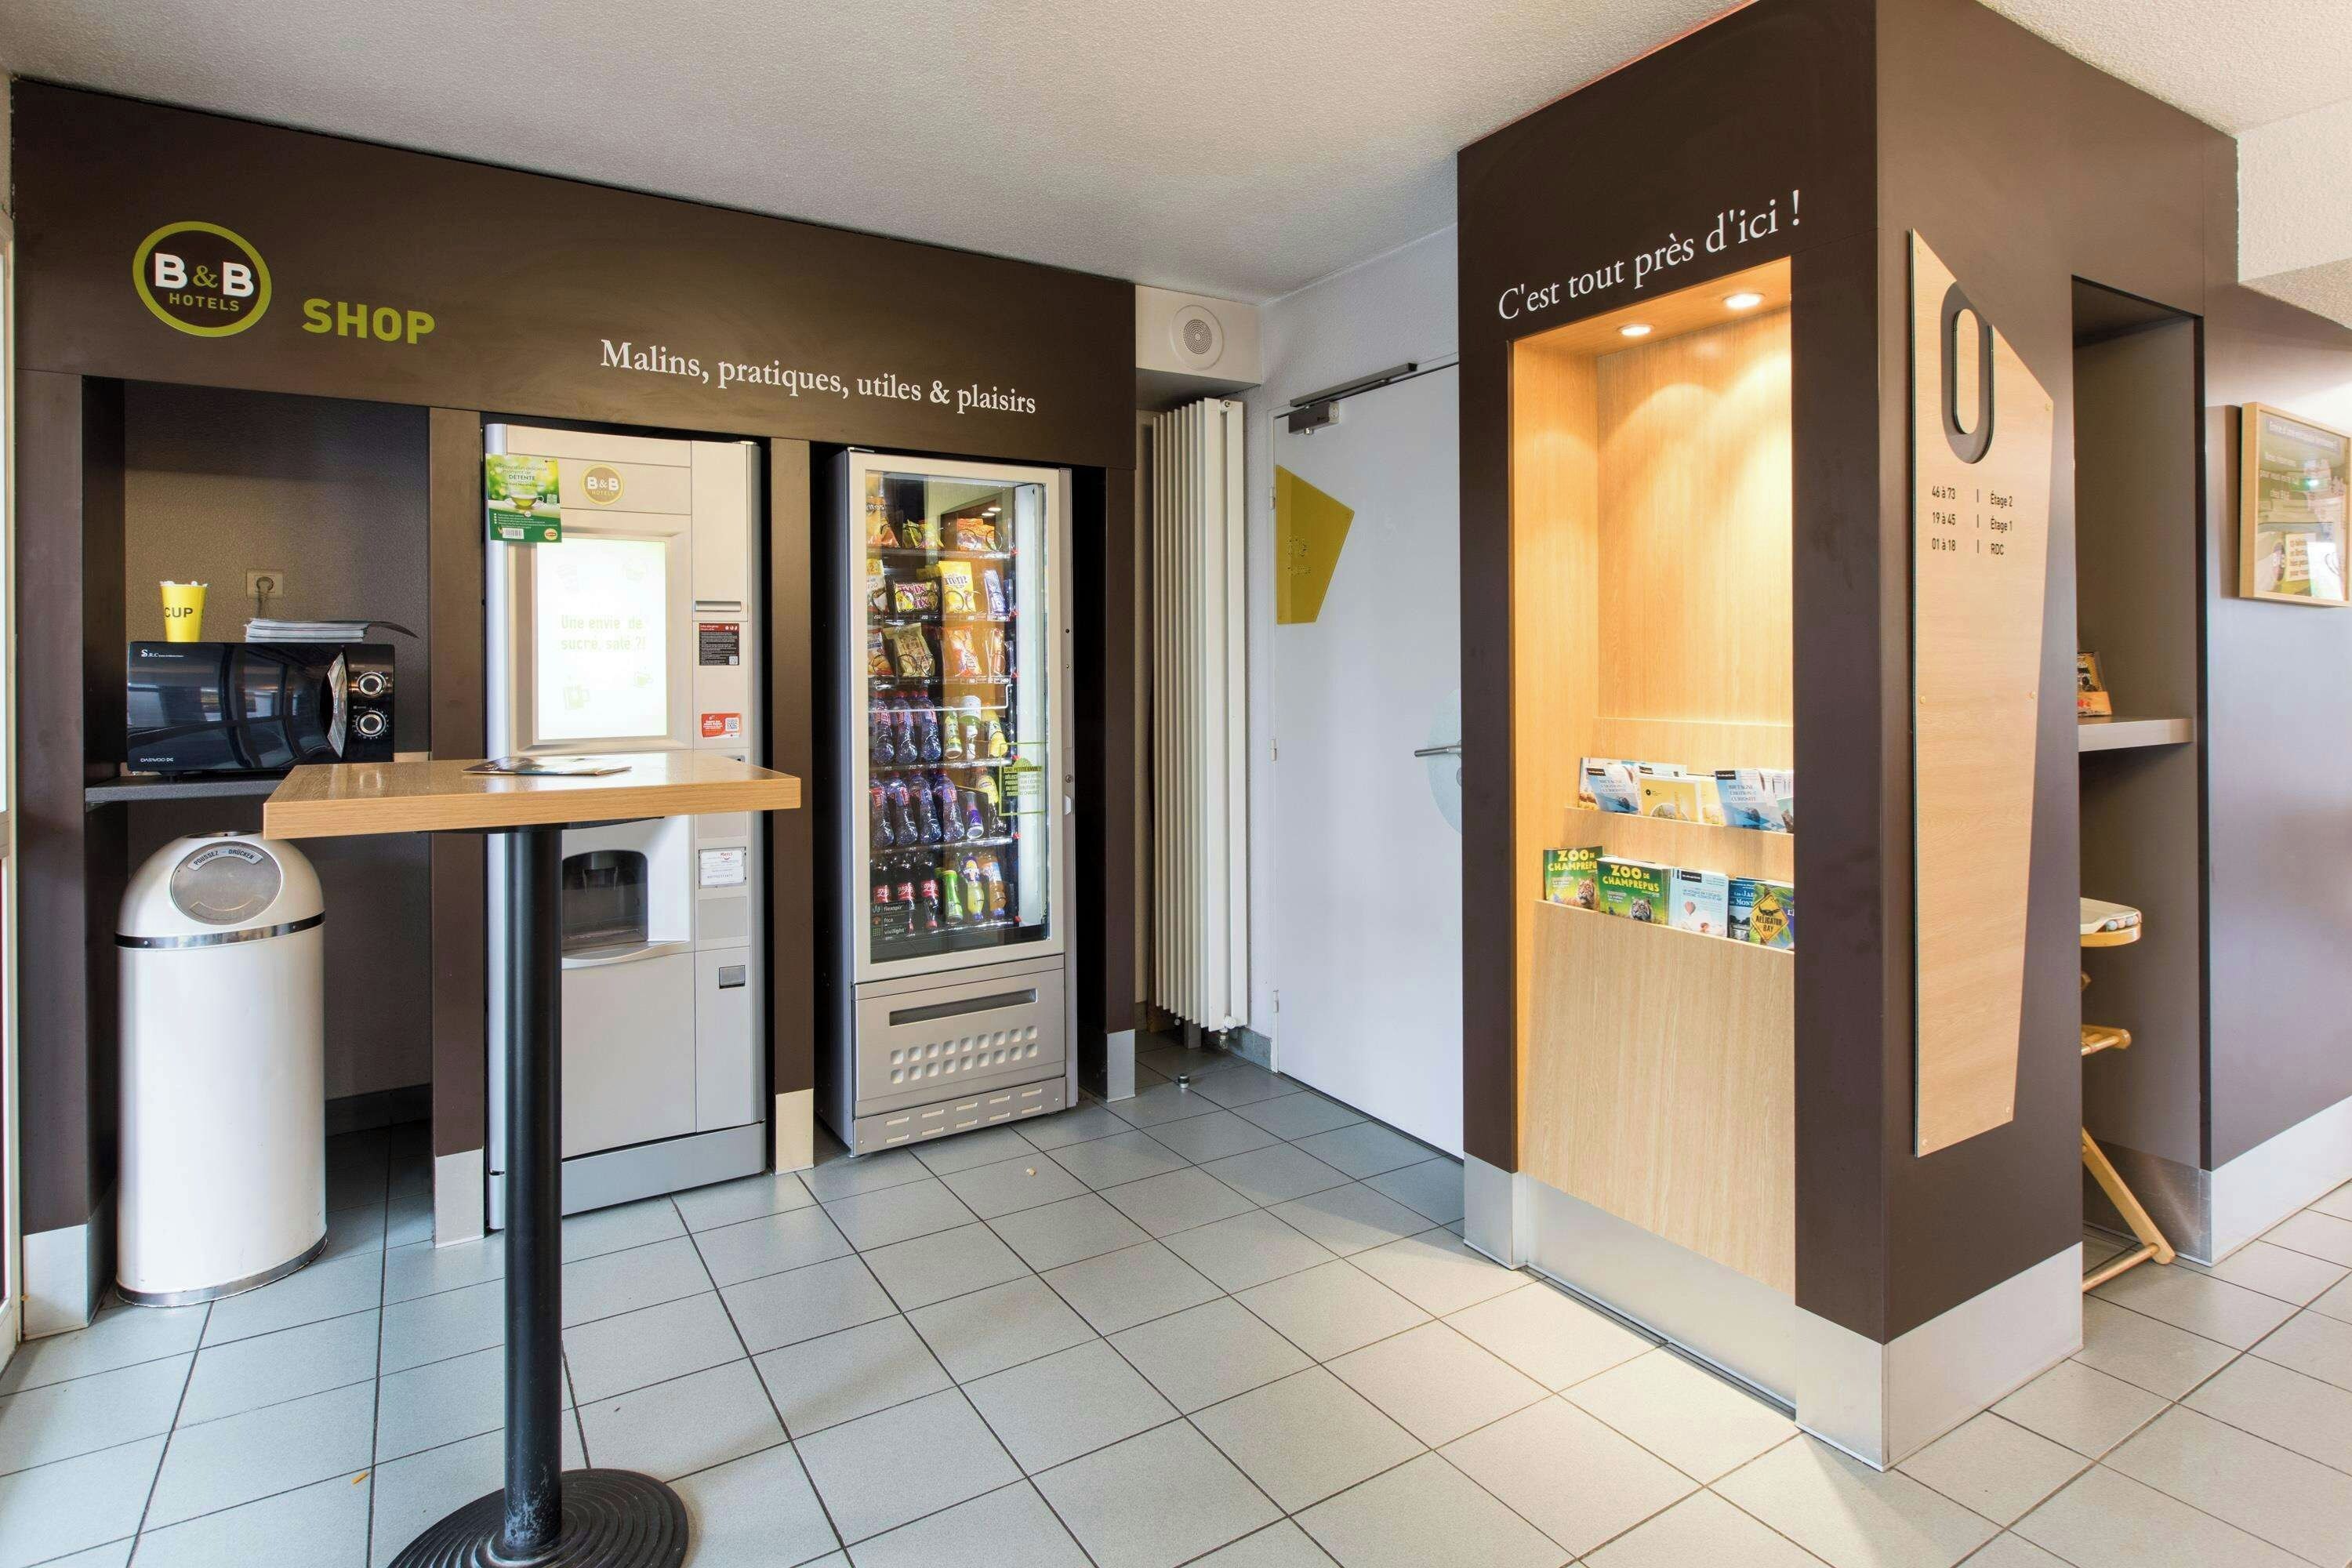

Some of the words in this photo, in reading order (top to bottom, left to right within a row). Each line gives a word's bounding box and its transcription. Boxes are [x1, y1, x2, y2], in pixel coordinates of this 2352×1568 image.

[1498, 282, 1560, 320] C'est
[1568, 260, 1625, 299] tout
[1634, 233, 1694, 289] près
[1705, 198, 1779, 254] d'ici
[169, 292, 240, 312] HOTELS
[302, 298, 436, 344] SHOP
[601, 339, 710, 383] Malins,
[718, 360, 849, 397] pratiques,
[857, 373, 922, 401] utiles
[929, 380, 951, 404] &
[956, 384, 1036, 414] plaisirs
[1932, 485, 1940, 498] 46
[1947, 487, 1956, 499] 73
[1991, 490, 2007, 509] Étage
[2009, 495, 2013, 507] 2
[1932, 512, 1940, 524] 19
[1947, 514, 1956, 526] 45
[1991, 515, 2007, 534] Étage
[1932, 538, 1940, 550] 01
[1947, 539, 1956, 551] 18
[1991, 543, 2005, 555] RDC
[164, 607, 194, 618] CUP
[561, 614, 584, 629] Une
[589, 614, 621, 629] envie
[628, 614, 644, 629] de
[193, 851, 219, 866] POUSSEZ
[228, 849, 255, 860] DRÜCKEN
[1558, 849, 1589, 862] ZOO
[1548, 861, 1597, 872] CHAMPREPU
[1610, 864, 1642, 880] ZOO
[1602, 875, 1660, 893] CHAMPREPUS
[1755, 915, 1783, 926] ALLIGATOR
